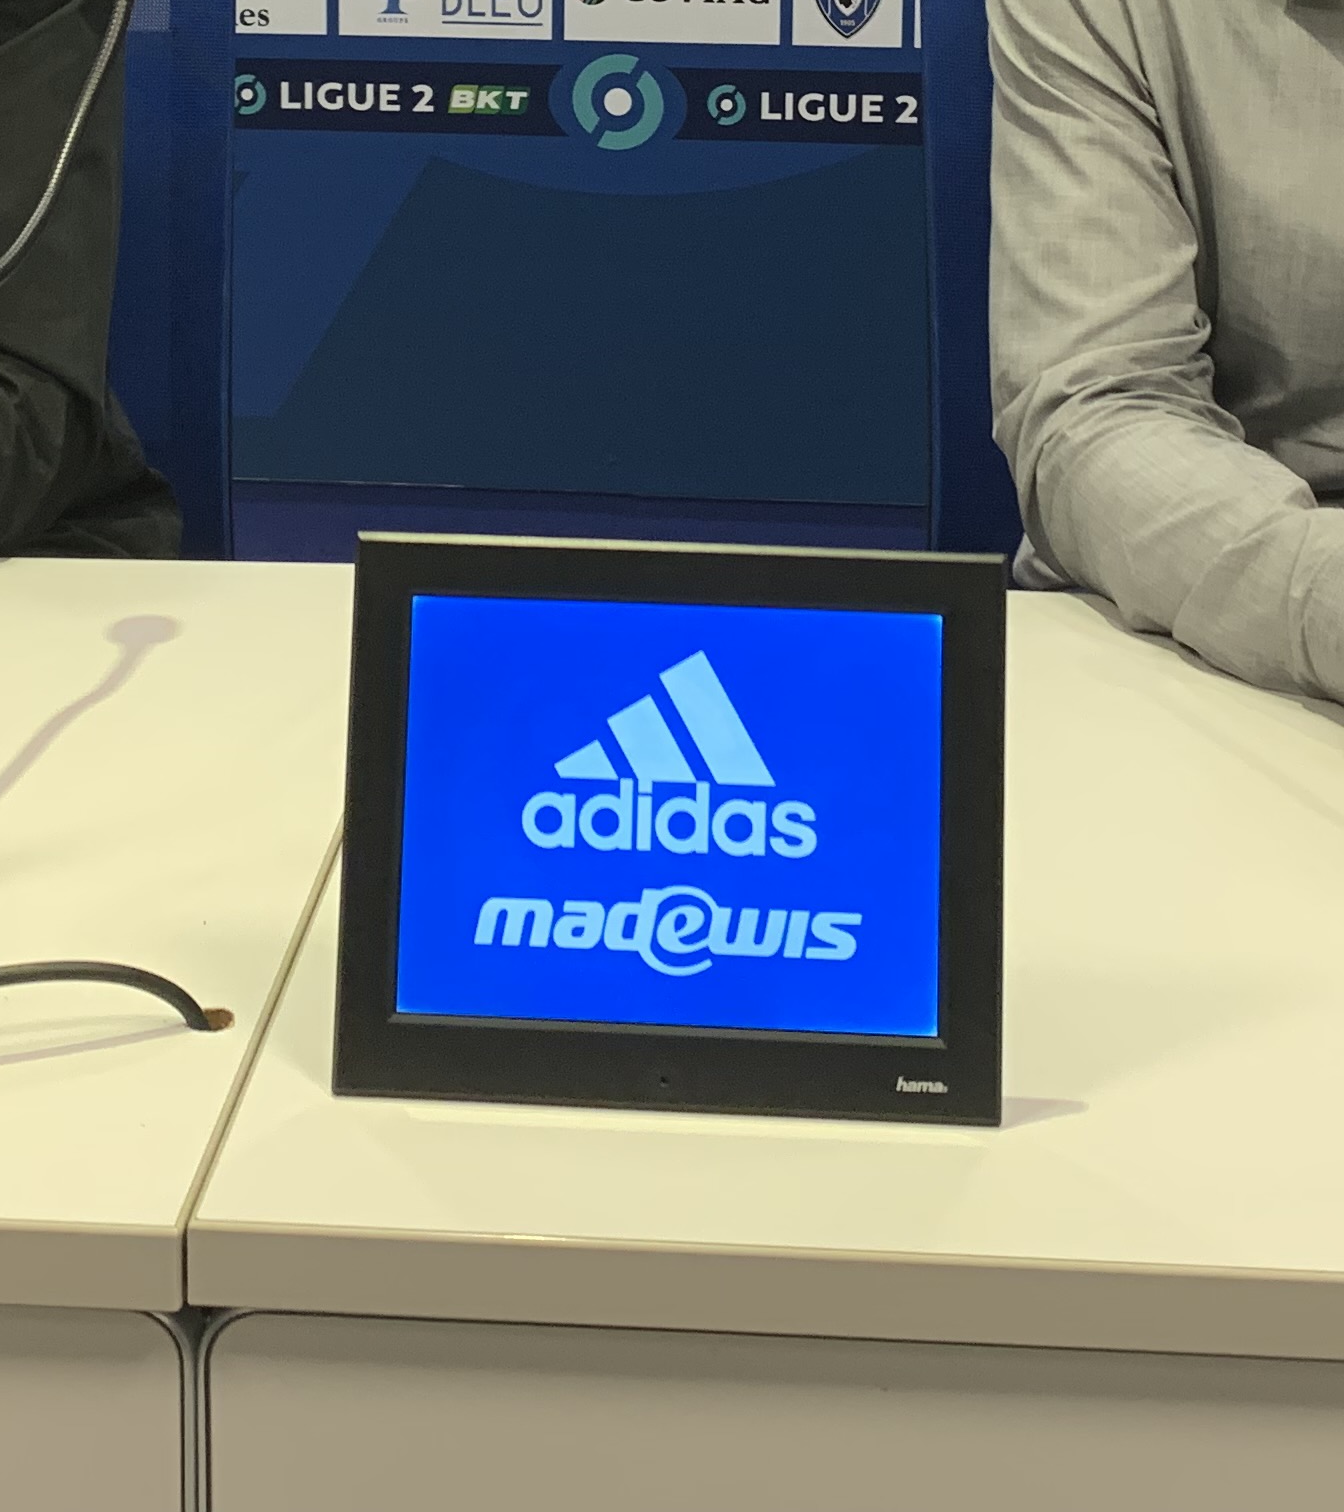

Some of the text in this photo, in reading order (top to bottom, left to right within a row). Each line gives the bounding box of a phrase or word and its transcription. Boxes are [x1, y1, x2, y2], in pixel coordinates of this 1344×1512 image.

[280, 81, 529, 112] LIGUE 2 BKT
[760, 91, 919, 124] LIGUE 2
[522, 778, 817, 858] adidas
